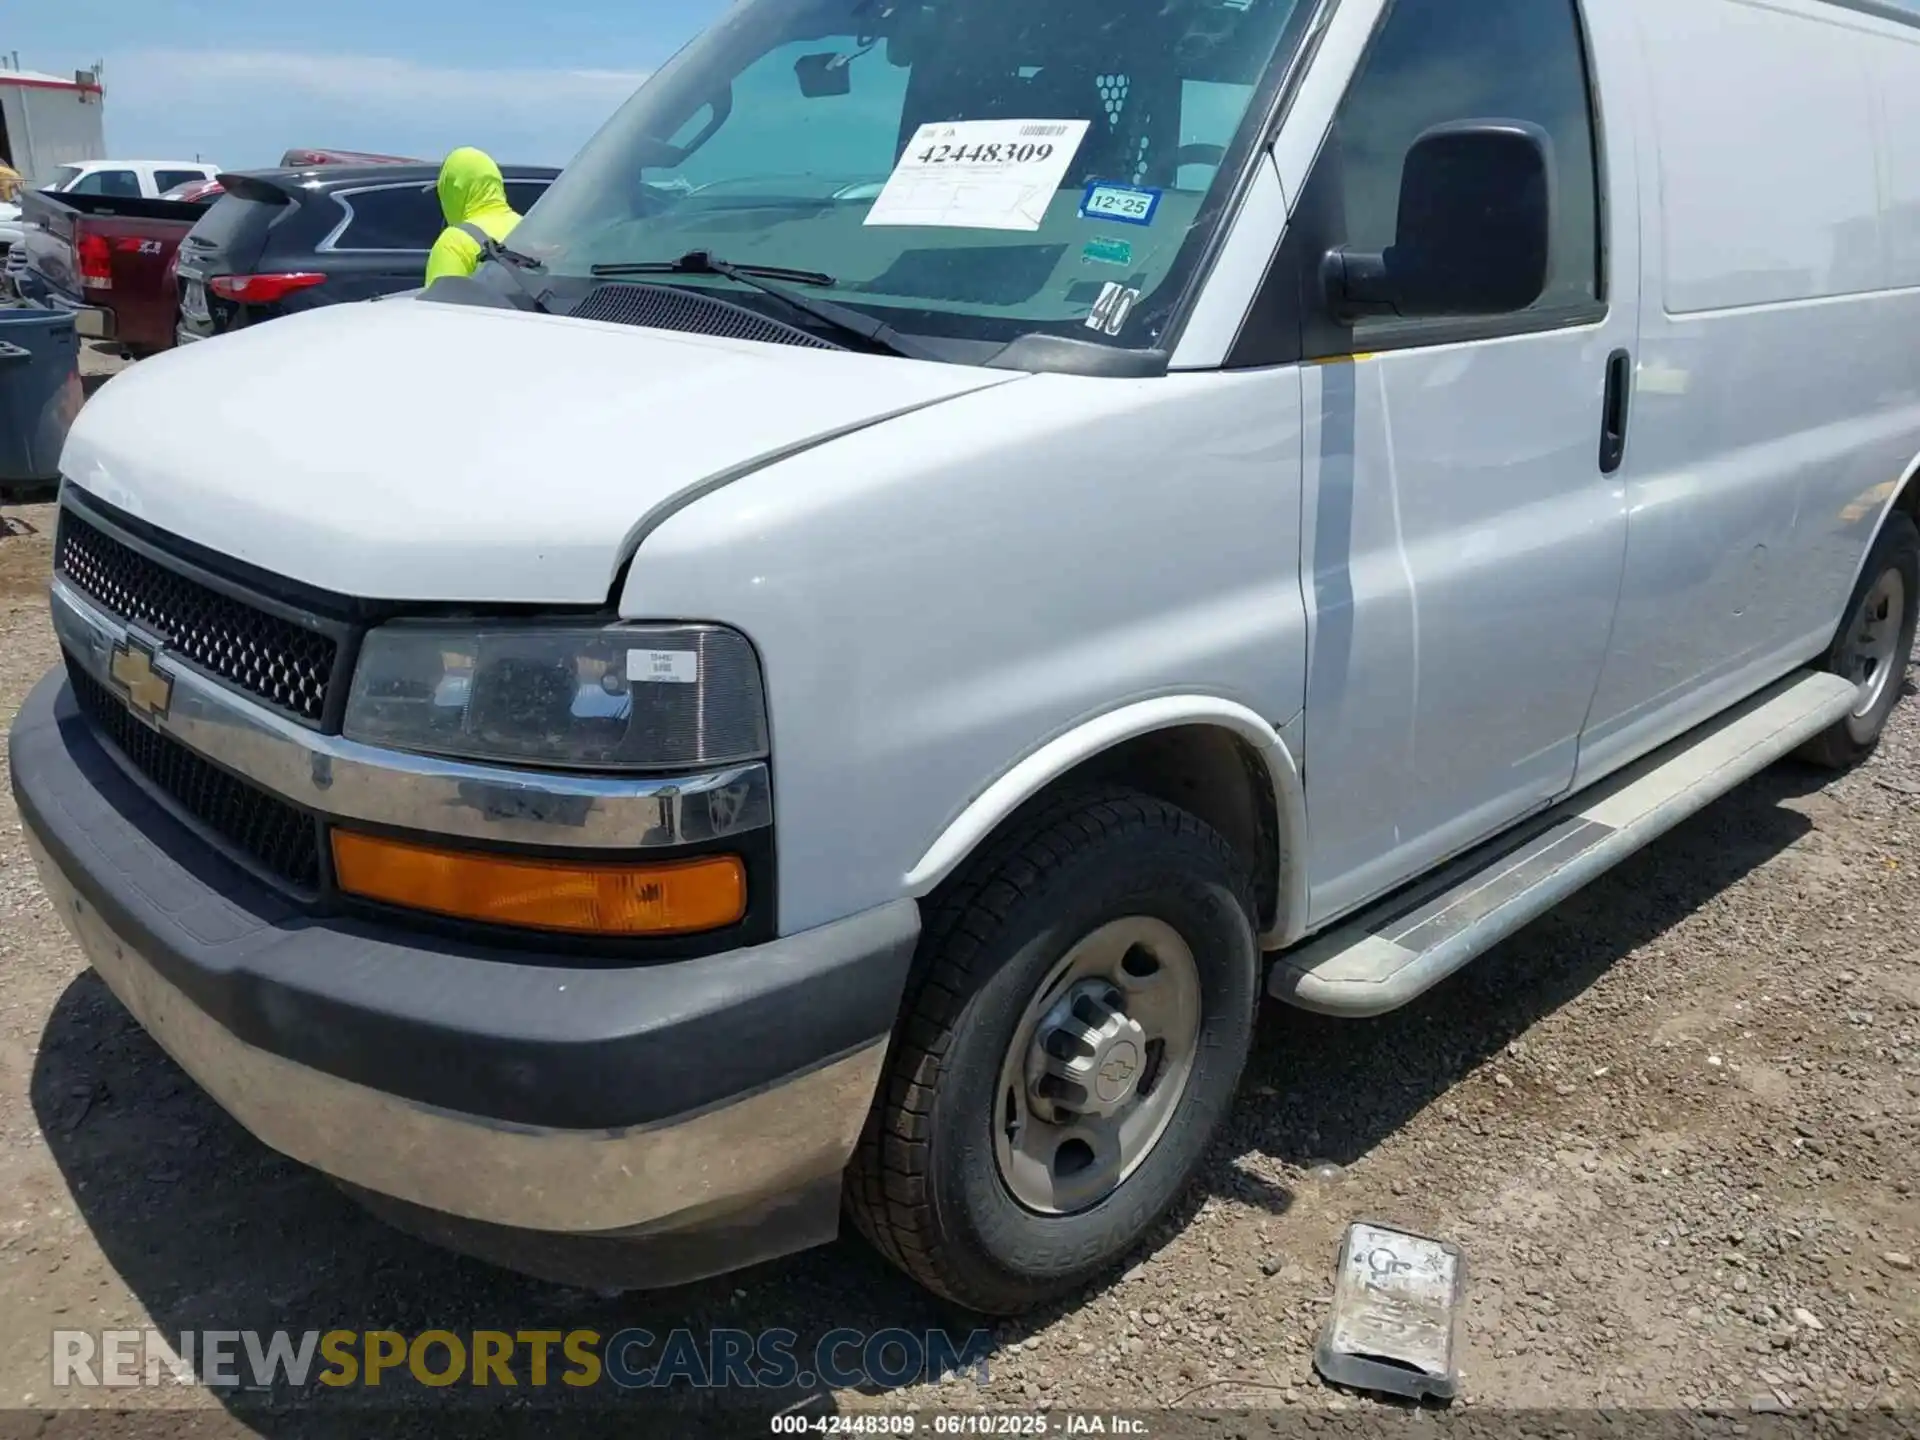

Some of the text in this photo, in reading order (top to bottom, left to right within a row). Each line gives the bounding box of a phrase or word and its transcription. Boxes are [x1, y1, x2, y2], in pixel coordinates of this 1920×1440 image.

[917, 143, 1054, 163] 42448309
[1094, 195, 1148, 214] 12 25
[1089, 283, 1138, 335] 40
